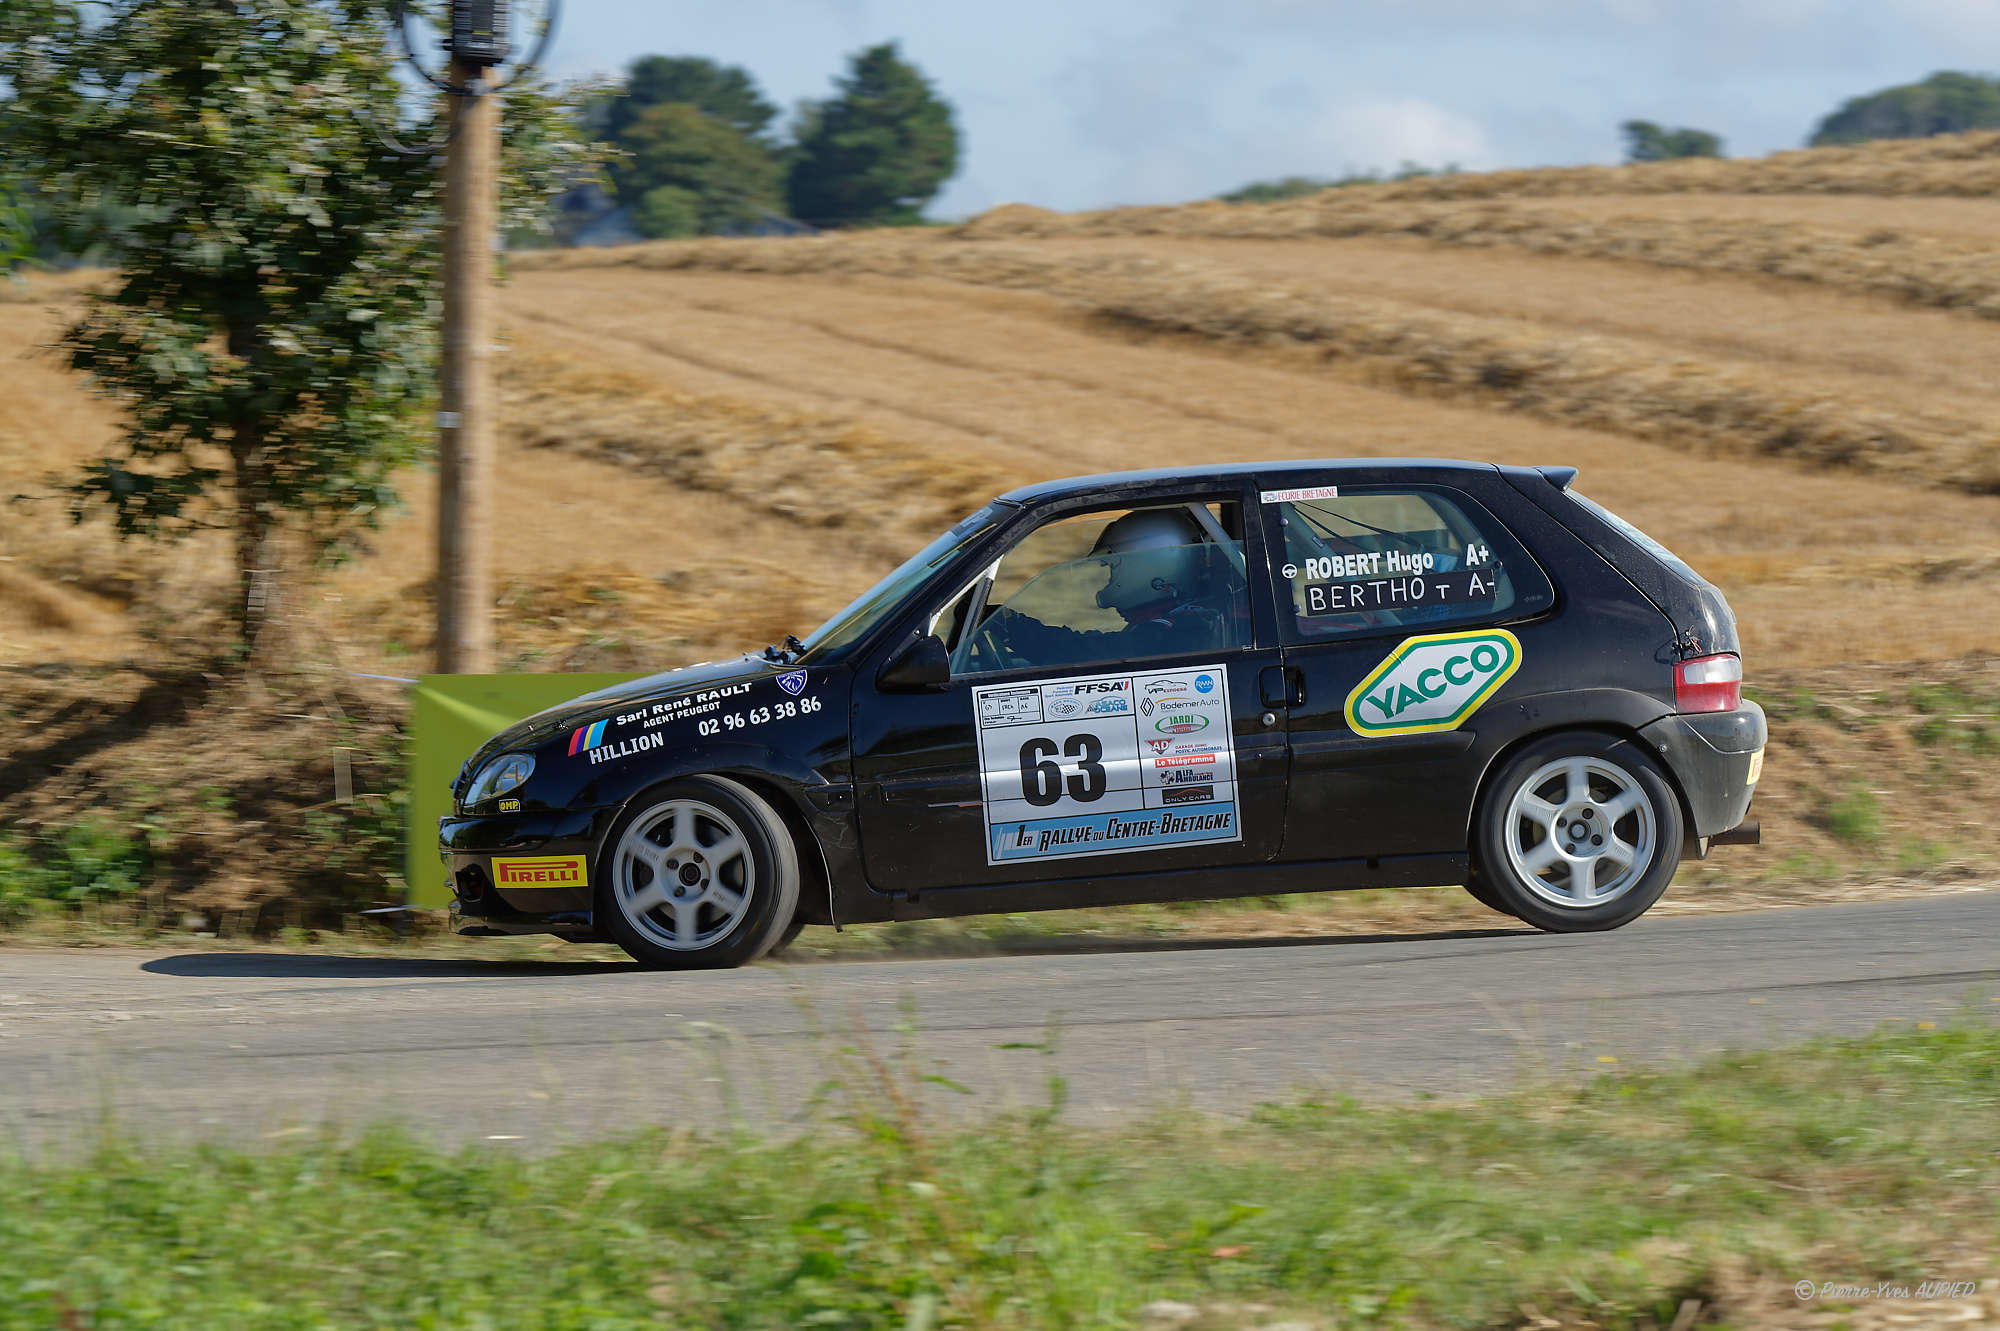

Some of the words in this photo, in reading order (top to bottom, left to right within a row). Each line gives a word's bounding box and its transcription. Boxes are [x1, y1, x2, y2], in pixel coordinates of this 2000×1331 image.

[1277, 490, 1300, 501] ECURIE
[1302, 487, 1336, 499] BRETAGNE
[1305, 552, 1381, 580] ROBERT
[1386, 549, 1434, 576] Hugo
[1465, 543, 1489, 567] A+
[1309, 577, 1425, 611] BERTHO
[1468, 572, 1494, 597] A-
[1074, 681, 1123, 695] FFSA
[1365, 644, 1500, 719] YACCO
[615, 708, 647, 726] Sarl
[652, 696, 691, 715] René
[696, 682, 752, 704] RAULT
[643, 711, 675, 729] AGENT
[676, 701, 721, 720] PEUGEOT
[698, 717, 721, 737] 02
[723, 711, 746, 731] 96
[749, 706, 771, 726] 63
[774, 700, 797, 721] 38
[800, 695, 822, 715] 86
[1160, 701, 1199, 710] Bodemer
[1199, 698, 1220, 706] Auto
[1169, 714, 1194, 725] JARDI
[589, 731, 665, 766] HILLION
[1152, 740, 1169, 752] AD
[1018, 733, 1107, 807] 63
[1156, 759, 1166, 767] Le
[1168, 755, 1213, 767] Télégramme
[500, 800, 519, 810] OMP
[1016, 824, 1033, 847] 1ER
[1038, 826, 1093, 852] RALLYE
[1106, 812, 1232, 840] CENTRE-BRETAGNE
[498, 861, 579, 882] PIRELLI
